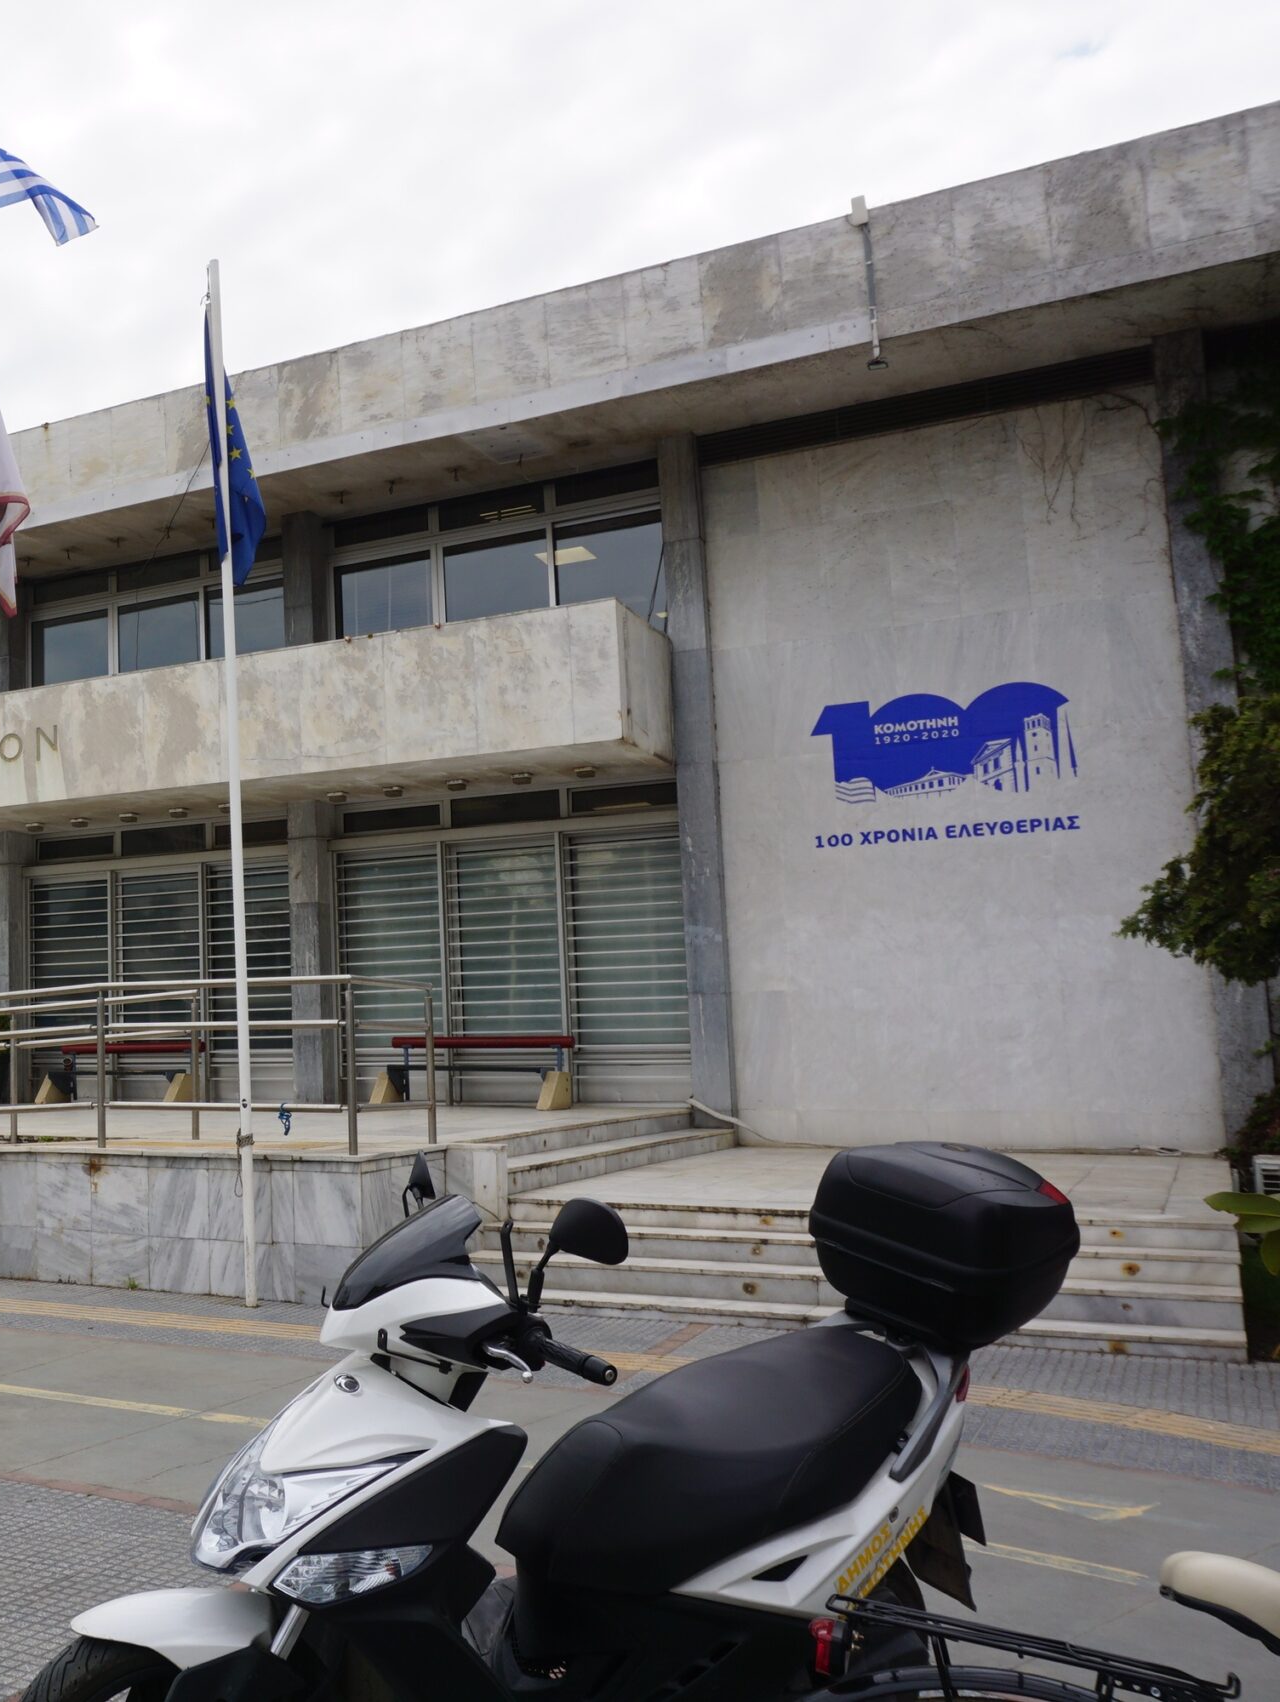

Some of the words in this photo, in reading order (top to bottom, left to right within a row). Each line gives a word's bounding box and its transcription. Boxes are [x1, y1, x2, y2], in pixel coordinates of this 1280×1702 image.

[873, 716, 959, 735] ΚΟΜΟΤΗΝΗ
[874, 728, 960, 745] 1920-2020
[815, 833, 853, 849] 100
[859, 826, 938, 846] ΧΡΟΝΙΑ
[945, 815, 1081, 839] ΕΛΕΥΘΕΡΙΑΣ
[836, 1522, 891, 1595] ΔΗΜΟΣ
